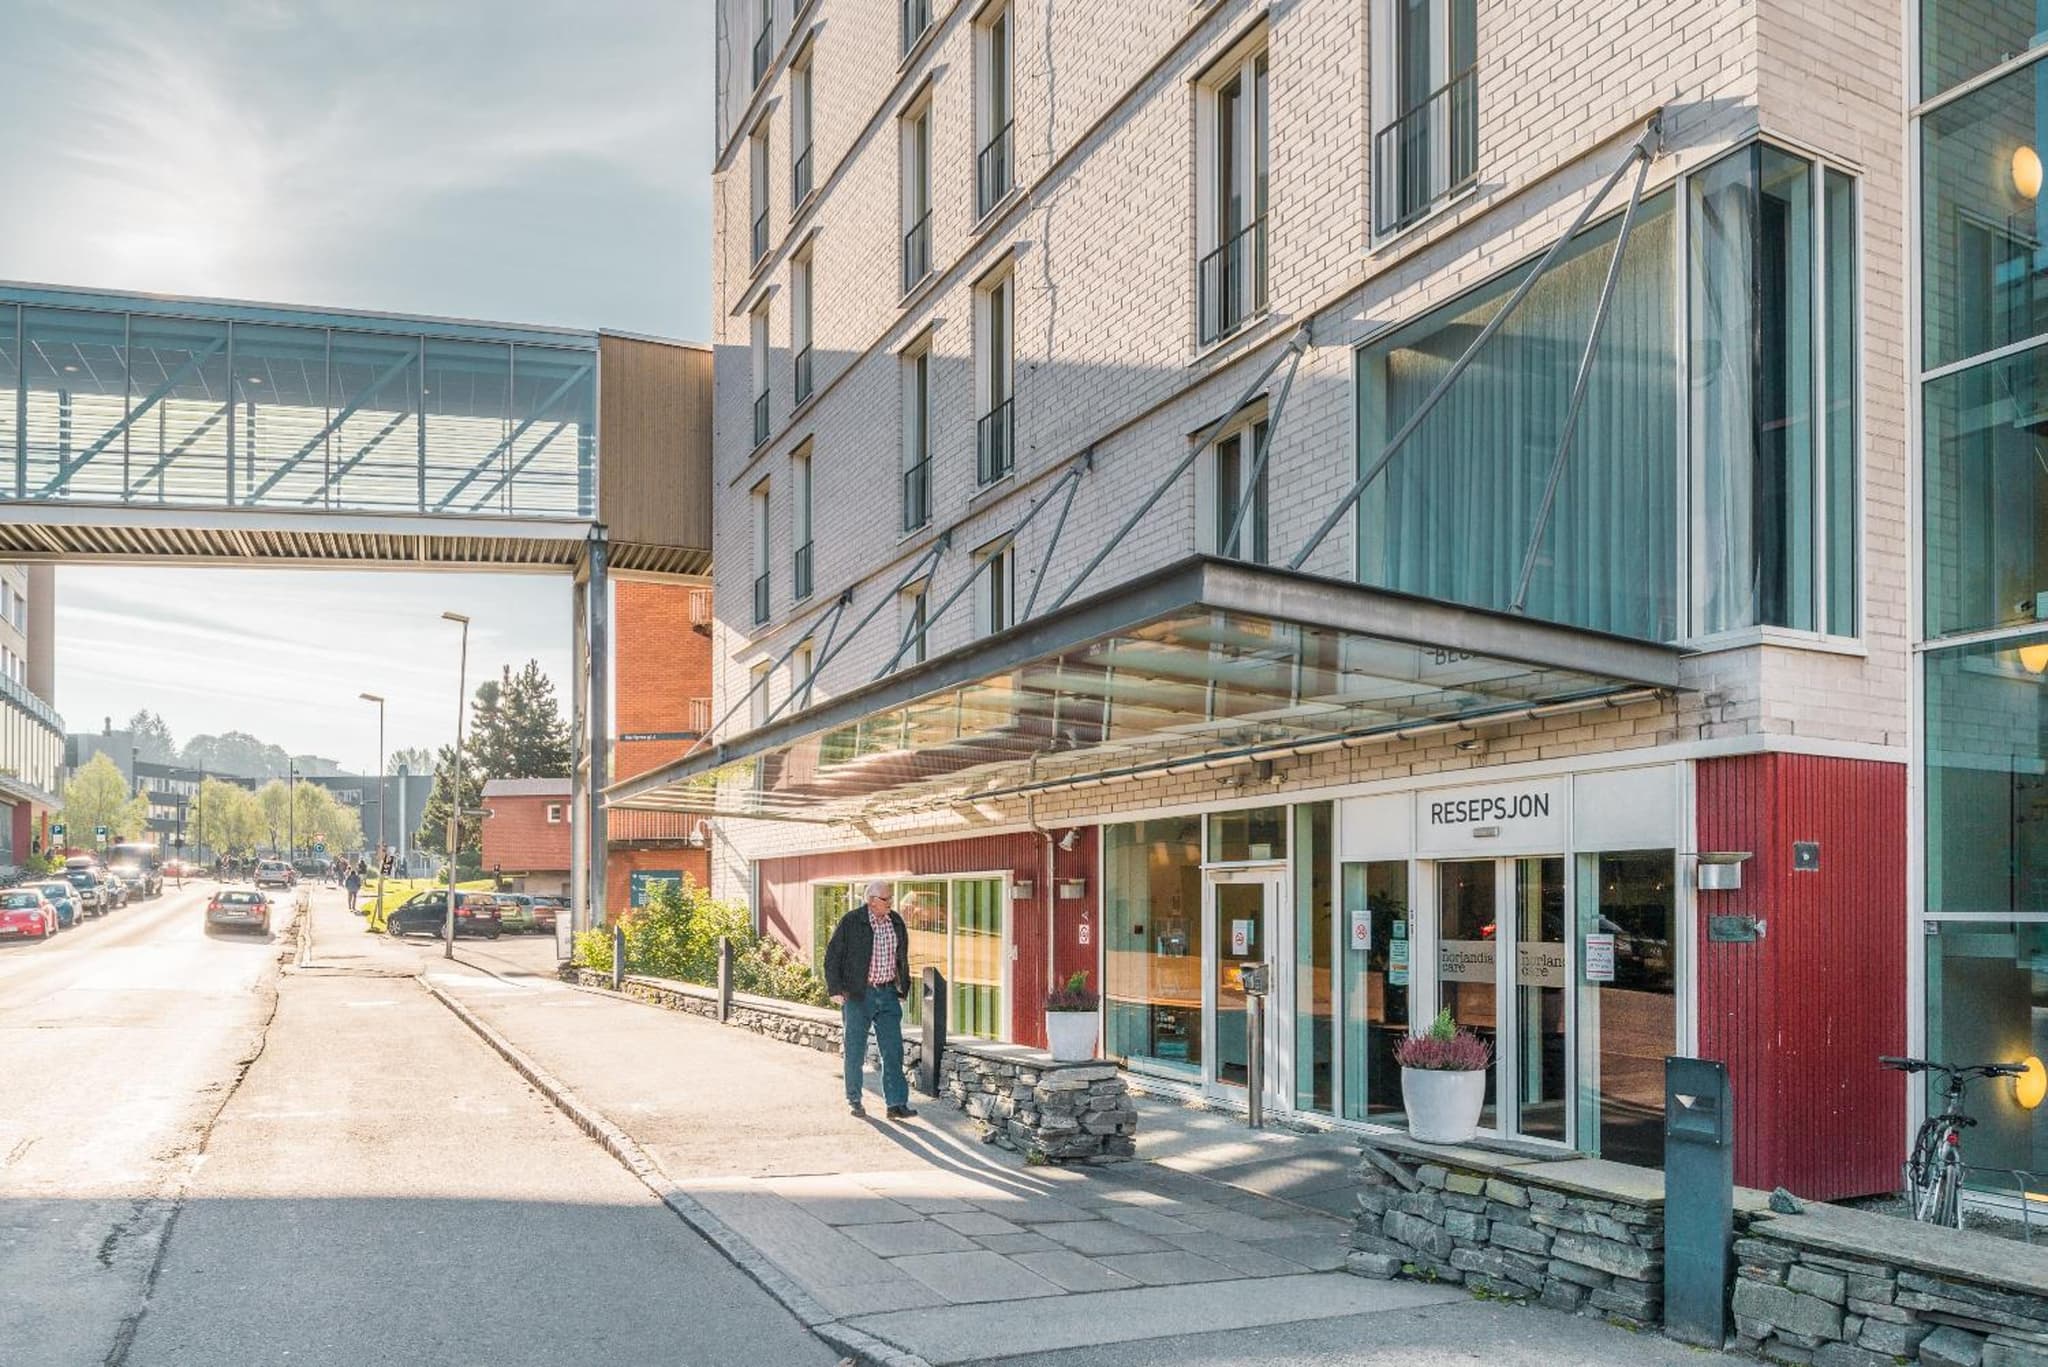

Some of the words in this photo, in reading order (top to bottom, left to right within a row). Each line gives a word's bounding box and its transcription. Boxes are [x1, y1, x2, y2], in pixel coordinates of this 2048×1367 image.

[1431, 792, 1549, 825] RESEPSJON
[1441, 951, 1493, 964] norlandia
[1521, 953, 1566, 967] norlan
[1441, 963, 1466, 973] care
